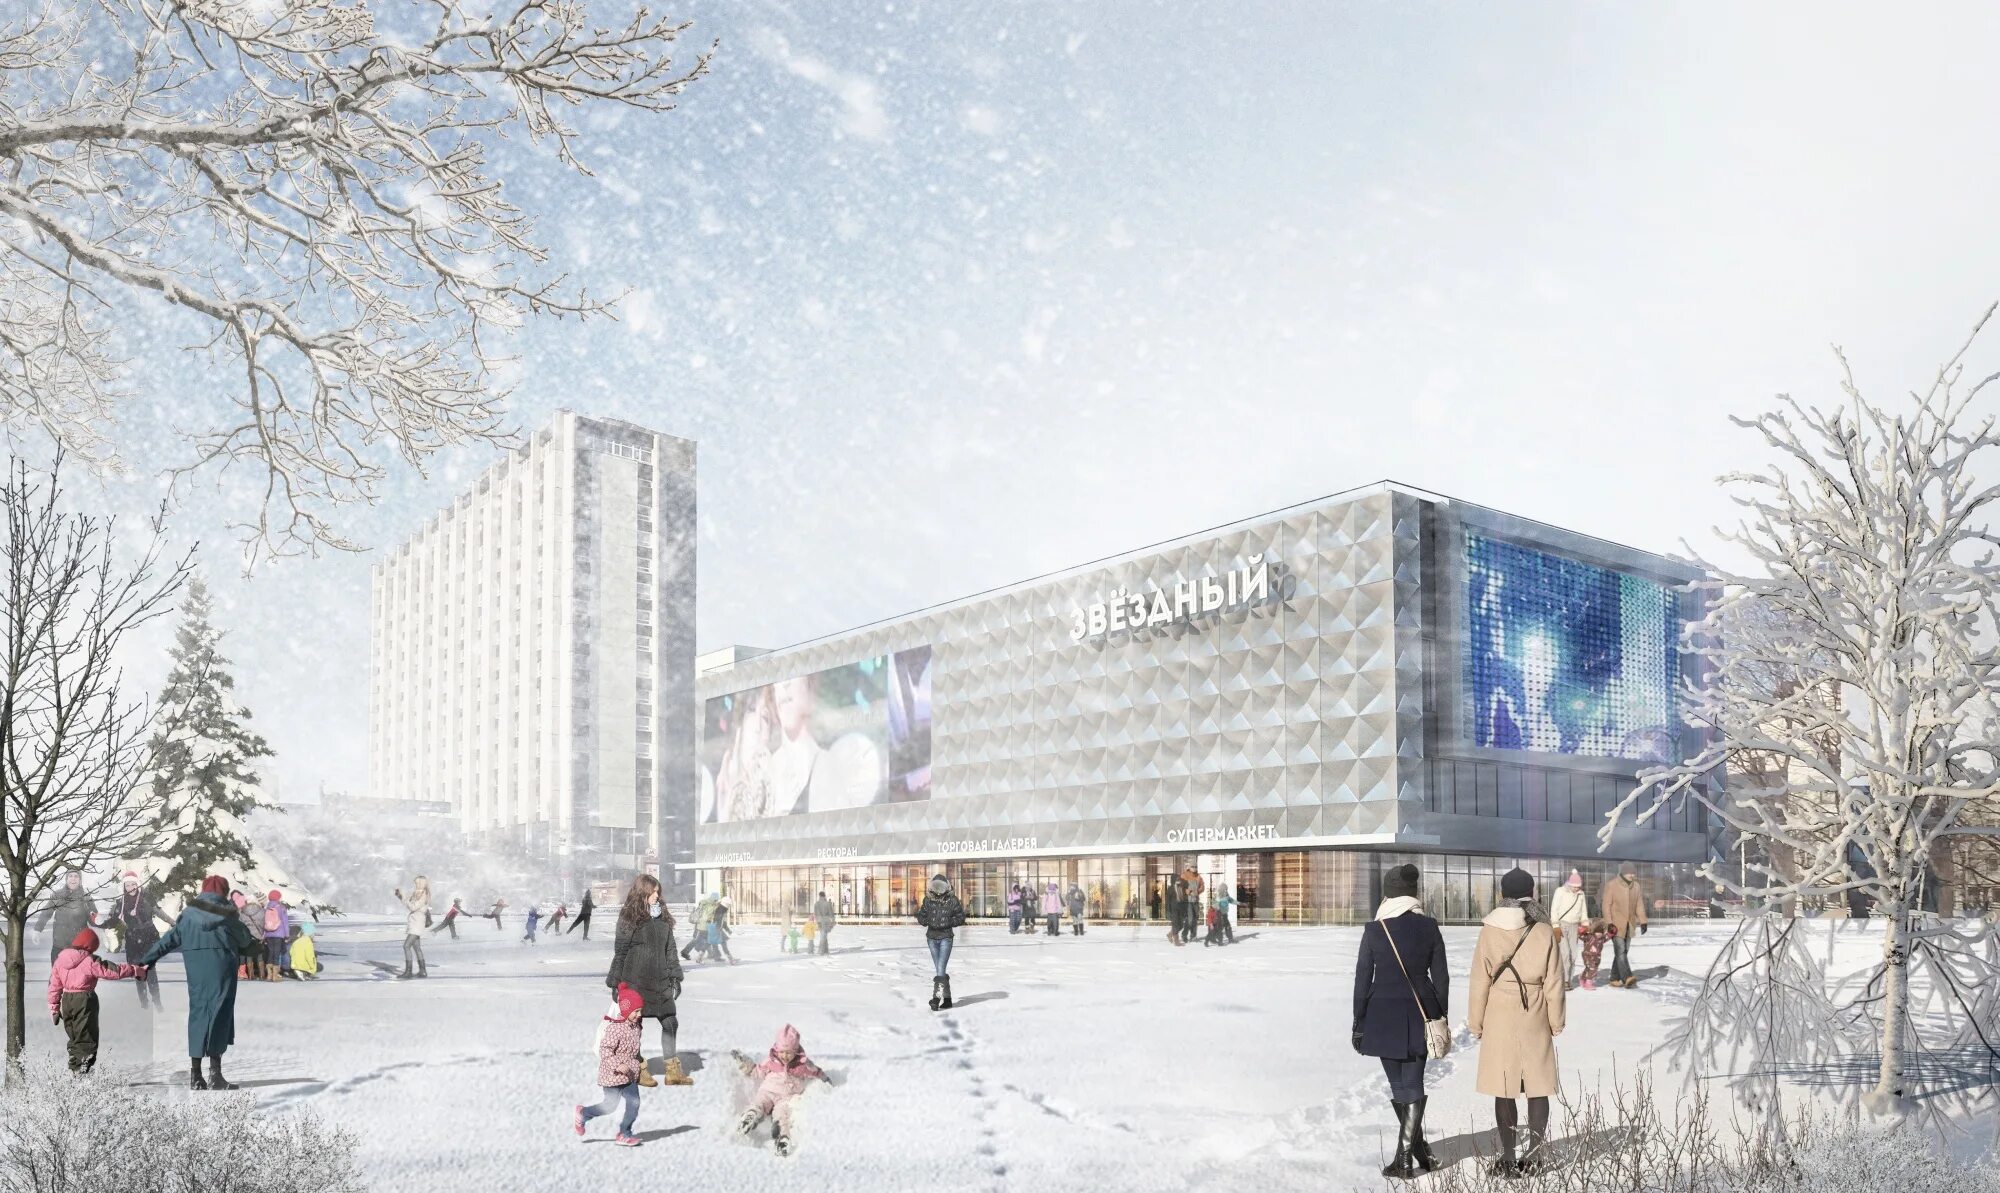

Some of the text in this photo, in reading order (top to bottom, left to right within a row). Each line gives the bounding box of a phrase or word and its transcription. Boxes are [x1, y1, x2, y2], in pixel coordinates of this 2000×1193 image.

[1069, 553, 1270, 640] ЗВЁЗДНЫЙ
[1166, 824, 1275, 843] СУПЕРМАРКЕТ
[817, 846, 858, 859] РЕСТОРАН
[937, 837, 1038, 853] ТОРГОВАЯ ГАЛЕРЕЯ
